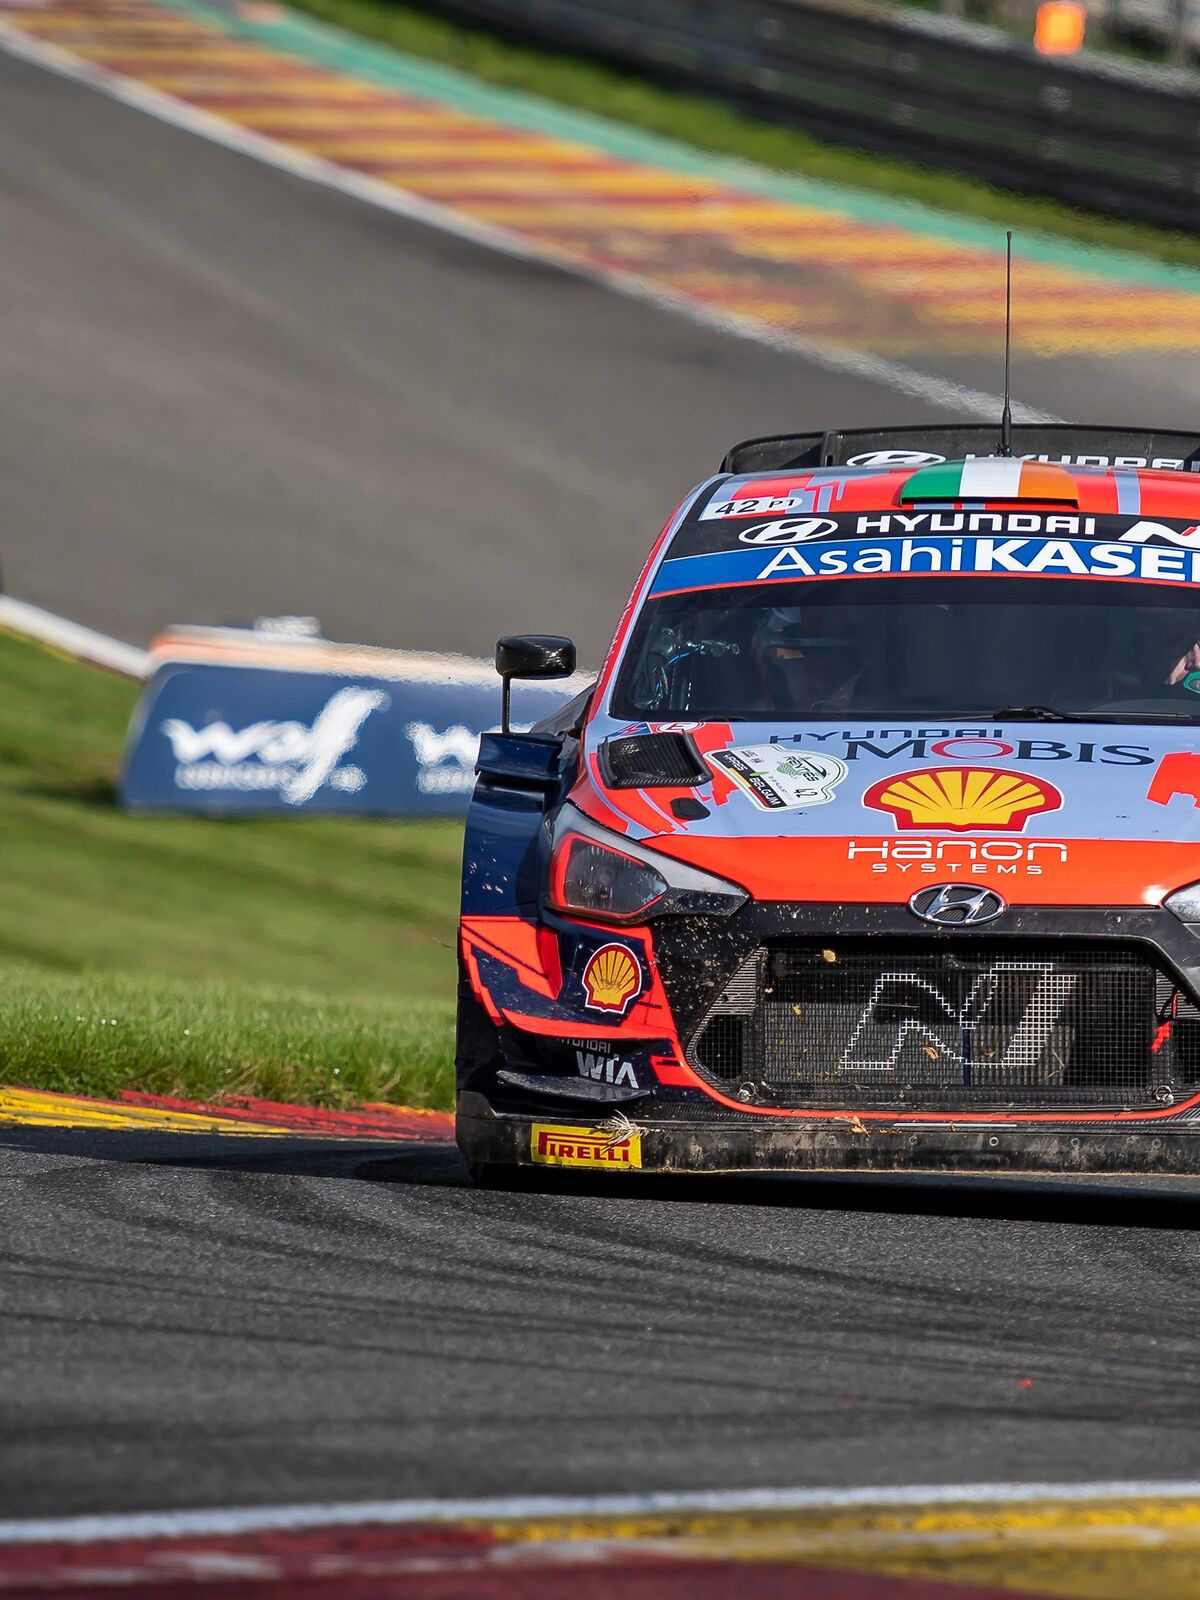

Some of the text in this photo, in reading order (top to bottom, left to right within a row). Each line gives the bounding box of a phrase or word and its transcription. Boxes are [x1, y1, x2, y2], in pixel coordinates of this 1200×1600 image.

[714, 500, 760, 515] 42
[856, 513, 1097, 534] HYUNDAI
[770, 729, 1002, 743] HYUNDAI
[843, 738, 1155, 766] MOBIS
[794, 788, 818, 798] 42
[872, 863, 1043, 875] SYSTEMS
[576, 1051, 639, 1089] WIA
[538, 1131, 631, 1162] PIRELLI
